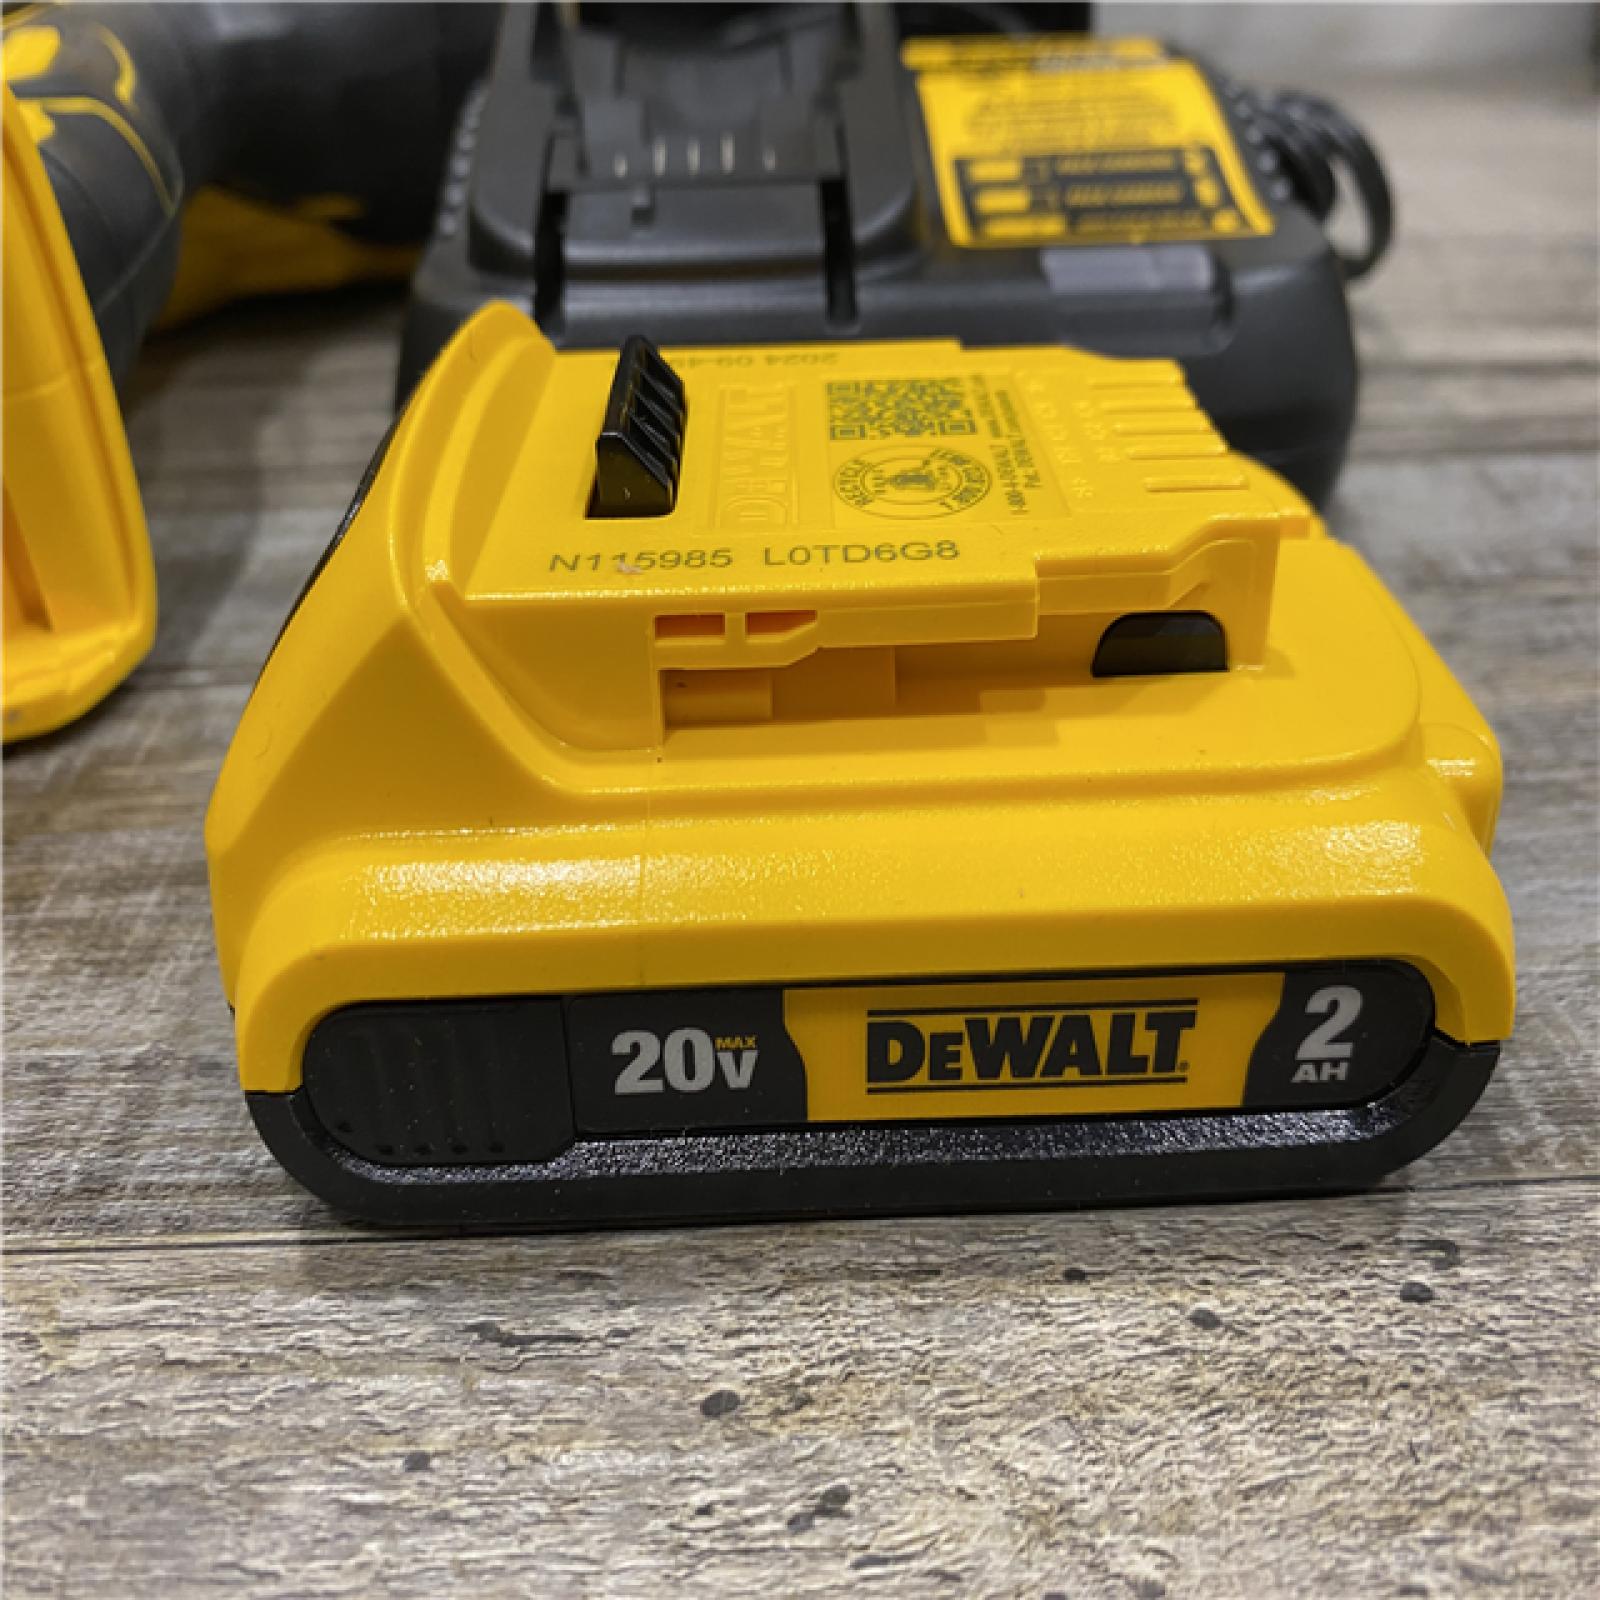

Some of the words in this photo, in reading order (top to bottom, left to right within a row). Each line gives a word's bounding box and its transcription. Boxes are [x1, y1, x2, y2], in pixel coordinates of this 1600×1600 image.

[549, 547, 733, 572] N115985
[1295, 984, 1363, 1061] 2
[715, 1035, 757, 1049] MAX
[611, 1027, 759, 1095] 20V
[1291, 1060, 1350, 1084] AH
